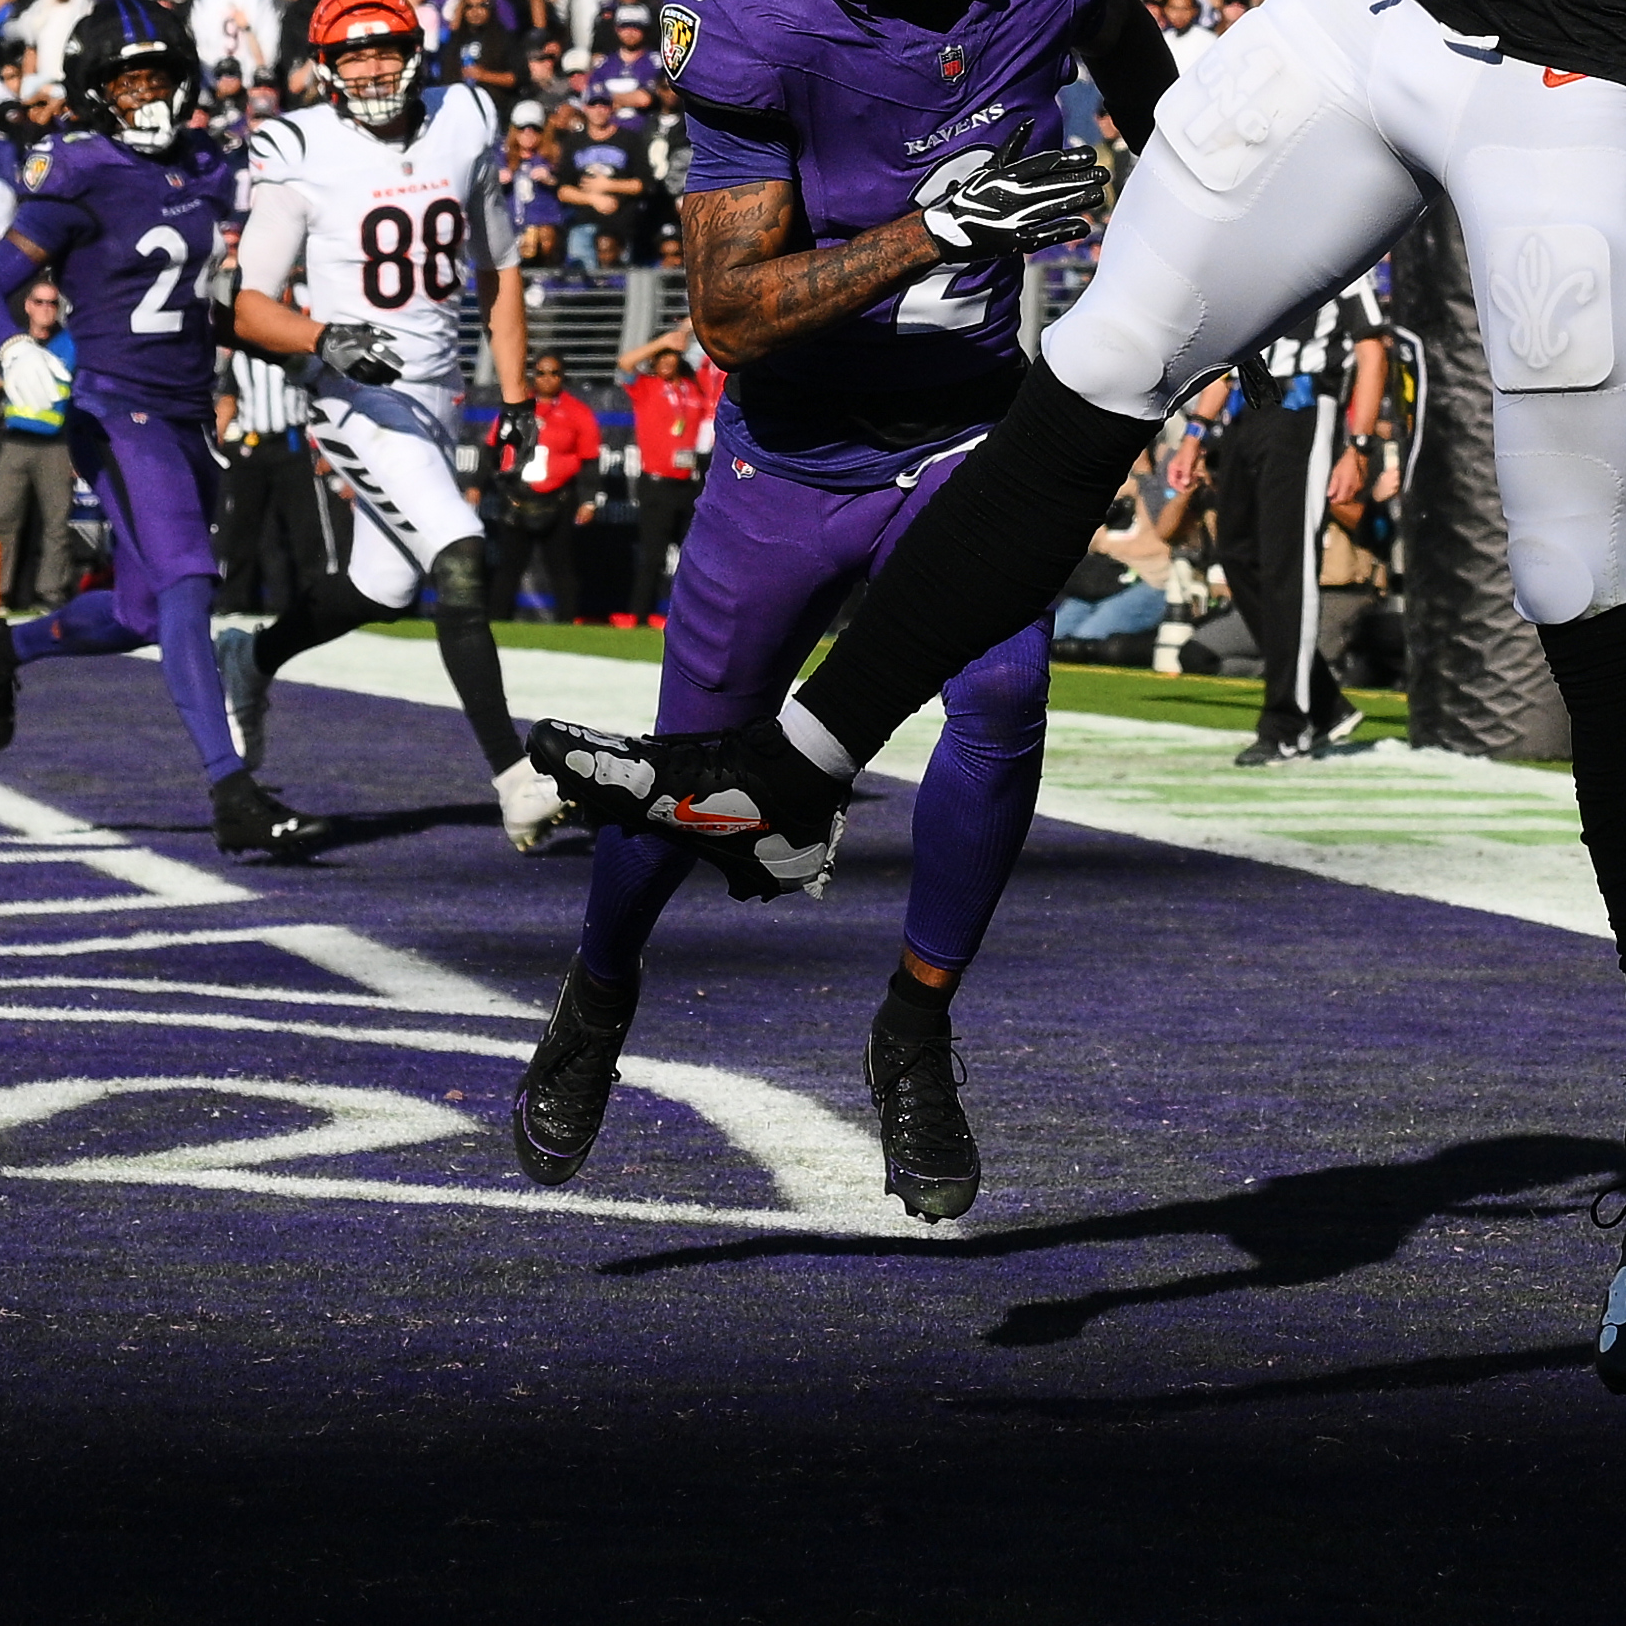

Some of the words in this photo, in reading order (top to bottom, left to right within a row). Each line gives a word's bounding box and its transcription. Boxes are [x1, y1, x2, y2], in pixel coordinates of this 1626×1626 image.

[663, 7, 695, 27] RAVENS
[903, 102, 1007, 156] RAVENS
[130, 223, 190, 334] 2
[359, 196, 466, 310] 88
